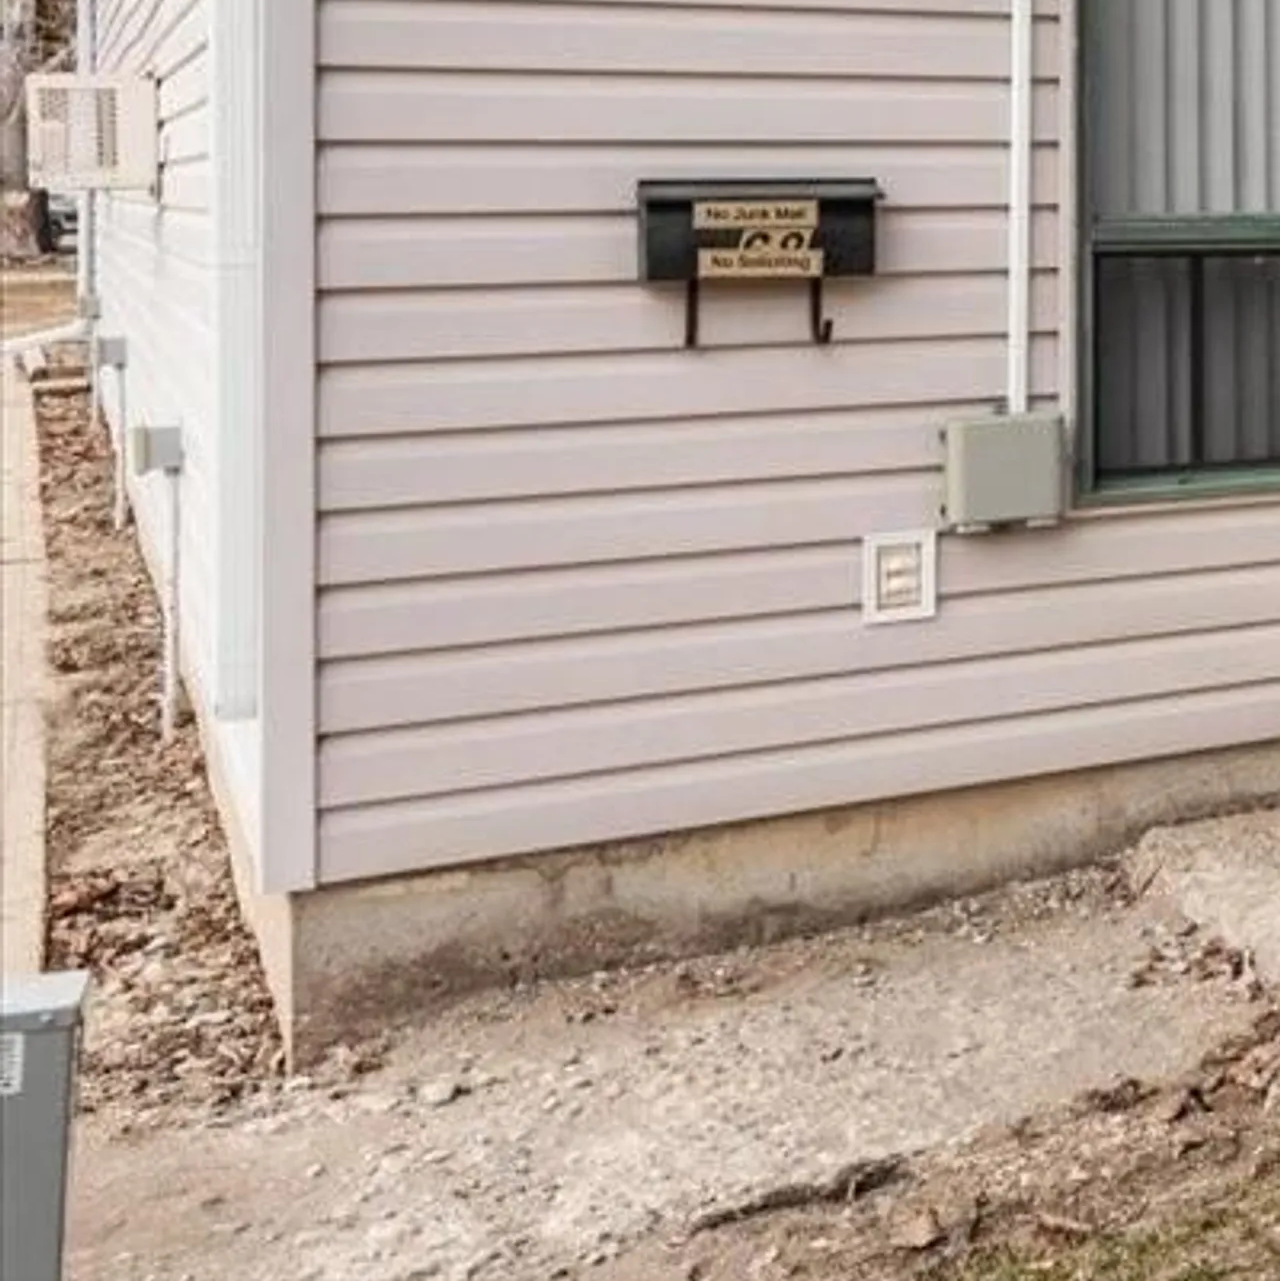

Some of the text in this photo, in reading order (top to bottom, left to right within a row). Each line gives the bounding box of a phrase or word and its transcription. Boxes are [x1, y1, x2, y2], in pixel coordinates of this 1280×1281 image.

[706, 204, 807, 221] No Junk Mail
[710, 255, 734, 269] No
